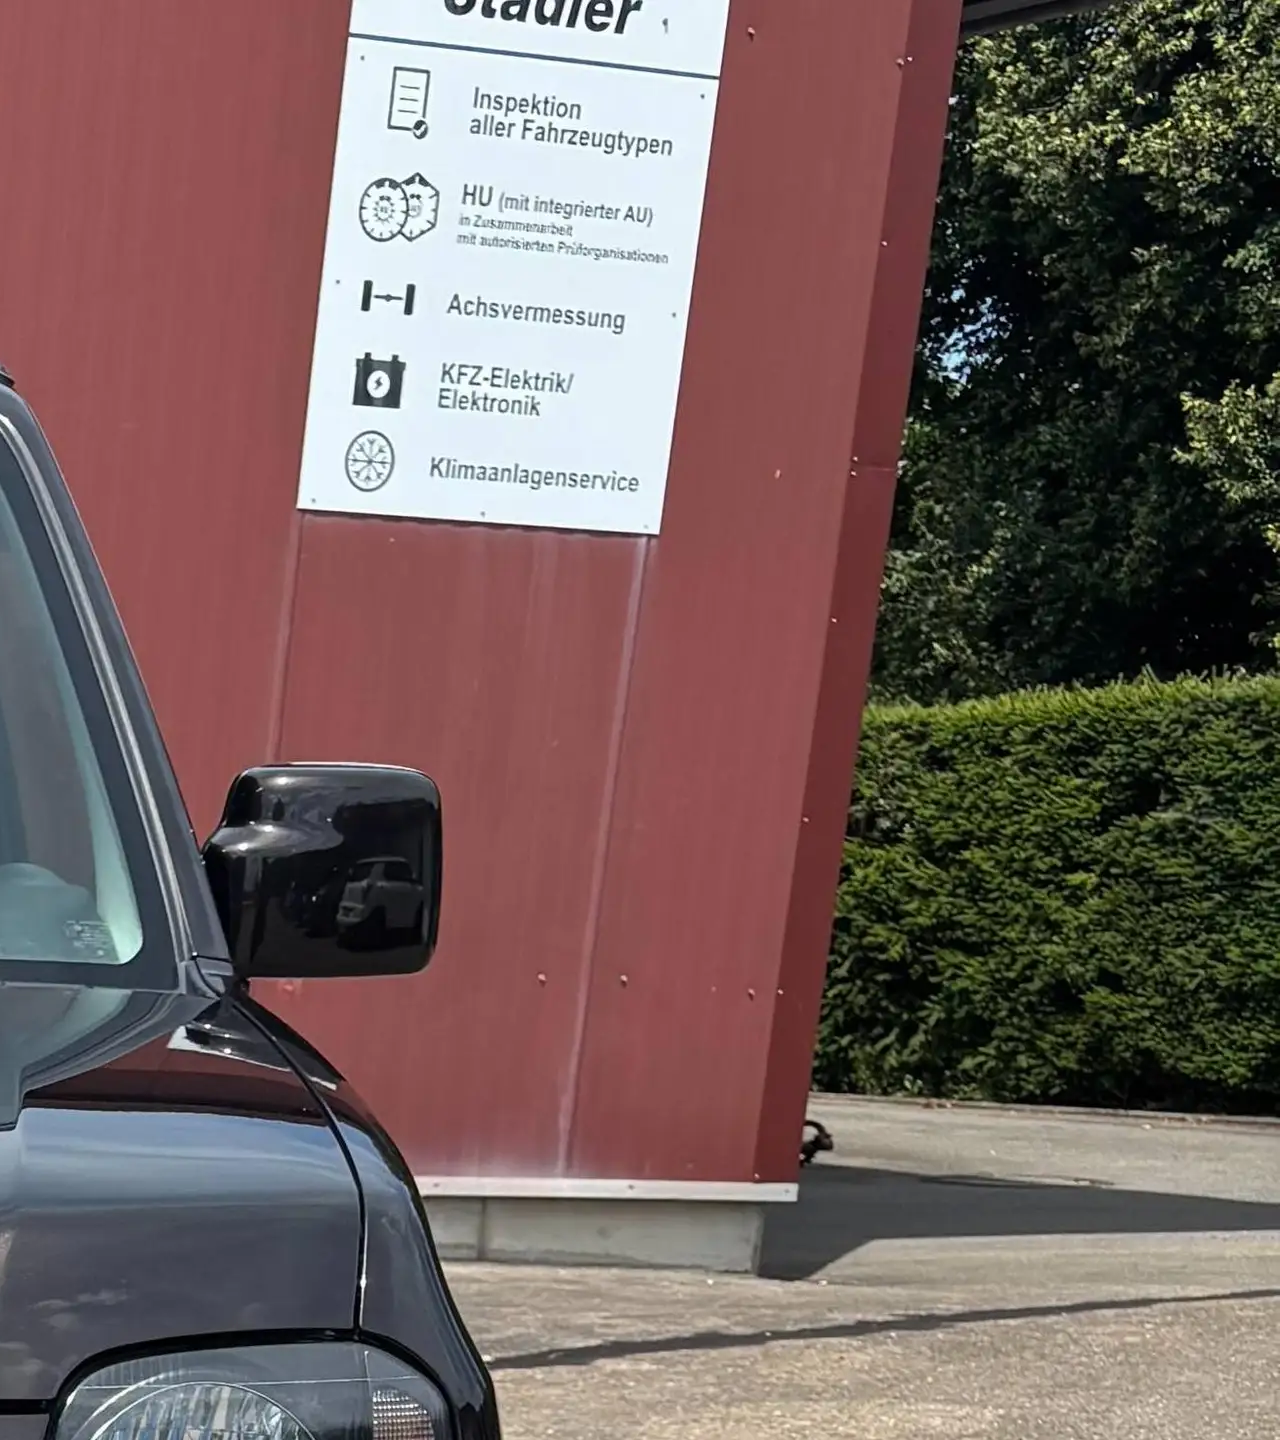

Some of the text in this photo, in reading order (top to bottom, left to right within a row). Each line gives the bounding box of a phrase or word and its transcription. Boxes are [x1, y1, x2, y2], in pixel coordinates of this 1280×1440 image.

[472, 86, 582, 120] Inspektion
[469, 114, 673, 158] aller Fahrzeugtypen
[461, 183, 654, 227] HU (mit integrierter AU)
[446, 293, 626, 335] Achsvermessung
[439, 363, 574, 395] KFZ-Elektrik/
[438, 388, 541, 416] Elektronik
[429, 456, 640, 493] Klimaanlagenservice
